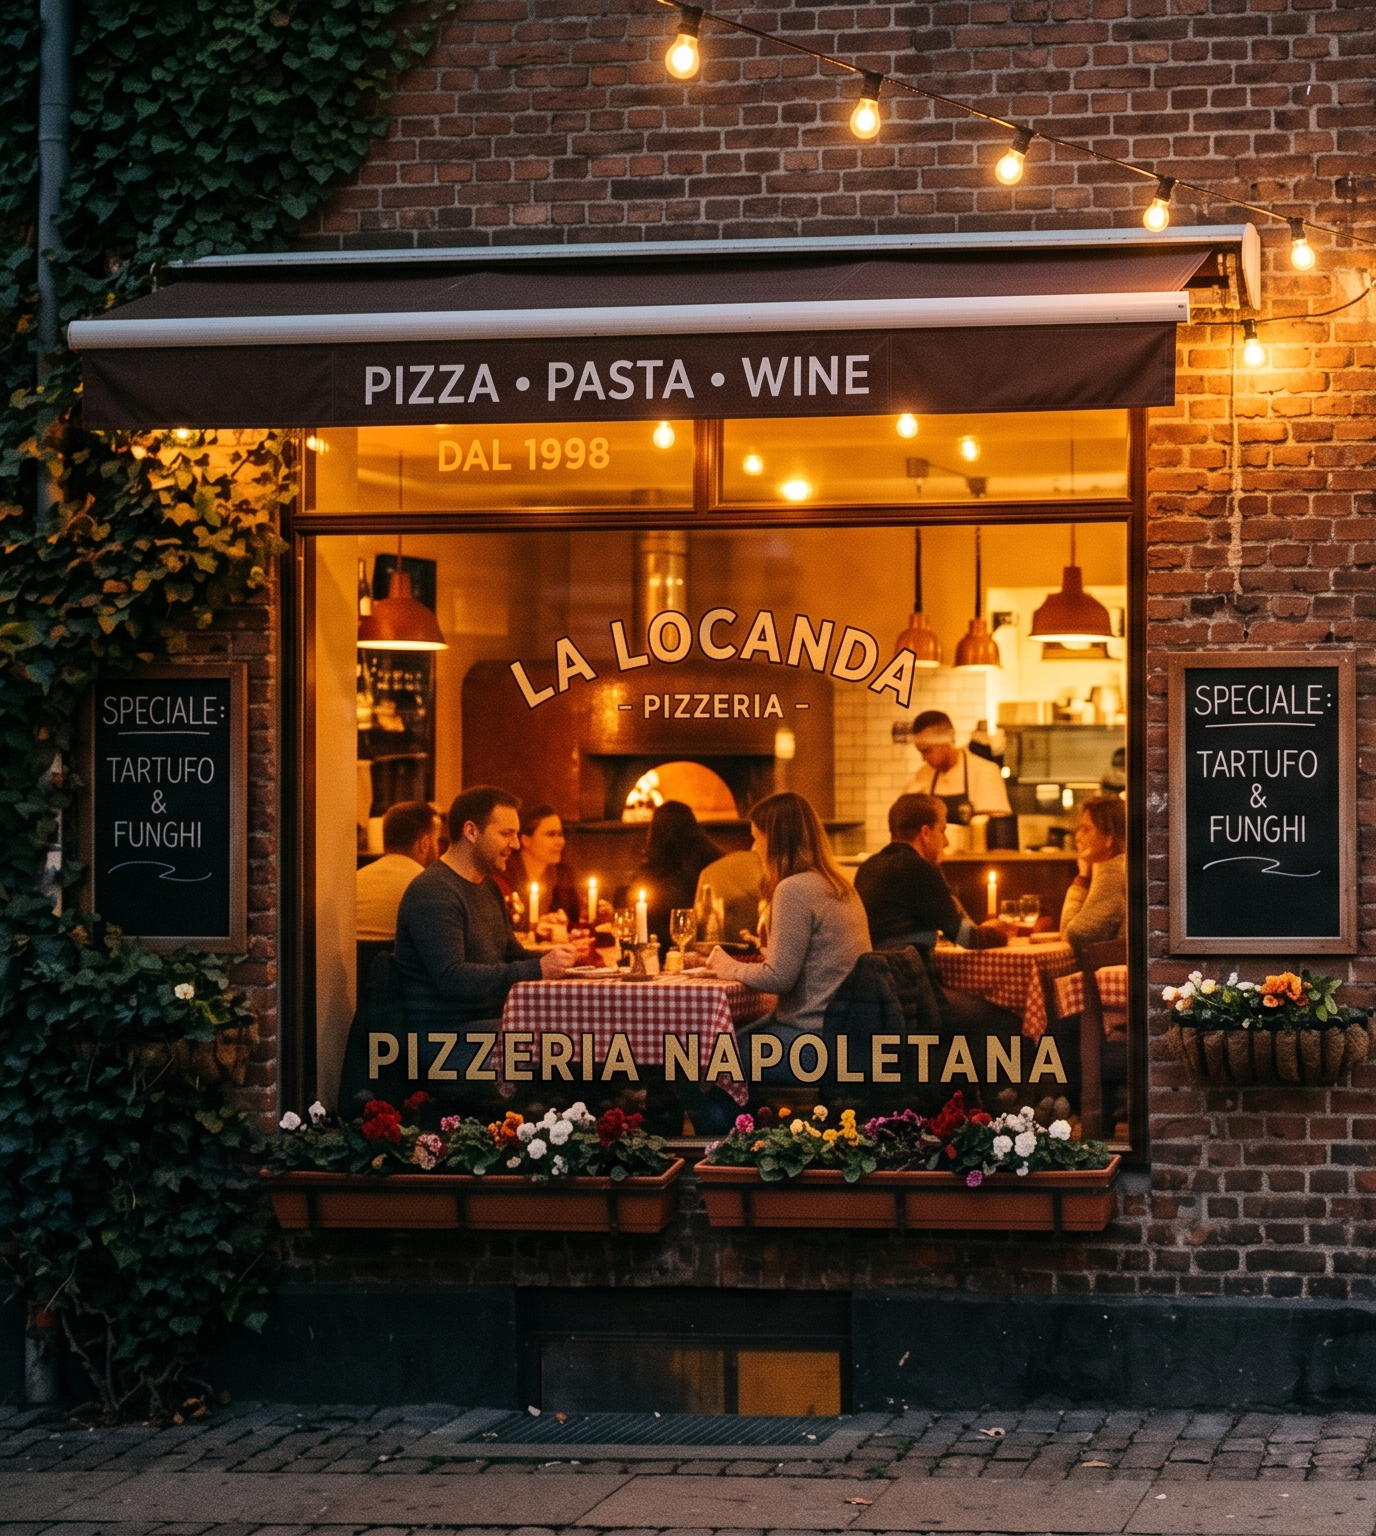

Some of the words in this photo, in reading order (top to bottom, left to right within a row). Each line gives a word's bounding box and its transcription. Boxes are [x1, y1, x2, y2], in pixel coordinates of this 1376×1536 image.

[364, 362, 501, 405] PIZZA
[547, 358, 695, 402] PASTA
[740, 354, 871, 398] WINE
[437, 438, 513, 472] DAL
[523, 436, 612, 471] 1998
[509, 635, 599, 710] LA
[609, 607, 918, 710] LOCANDA
[102, 695, 226, 725] SPECIALE:
[643, 693, 784, 720] PIZZERIA
[1193, 684, 1333, 716] SPECIALE:
[106, 756, 216, 785] TARTUFO
[1196, 749, 1319, 779] TARTUFO
[150, 789, 167, 815] &
[1249, 782, 1268, 809] &
[113, 820, 202, 848] FUNGHI
[1209, 815, 1306, 843] FUNGHI
[367, 1030, 642, 1084] PIZZERIA
[663, 1032, 1070, 1086] NAPOLETANA
